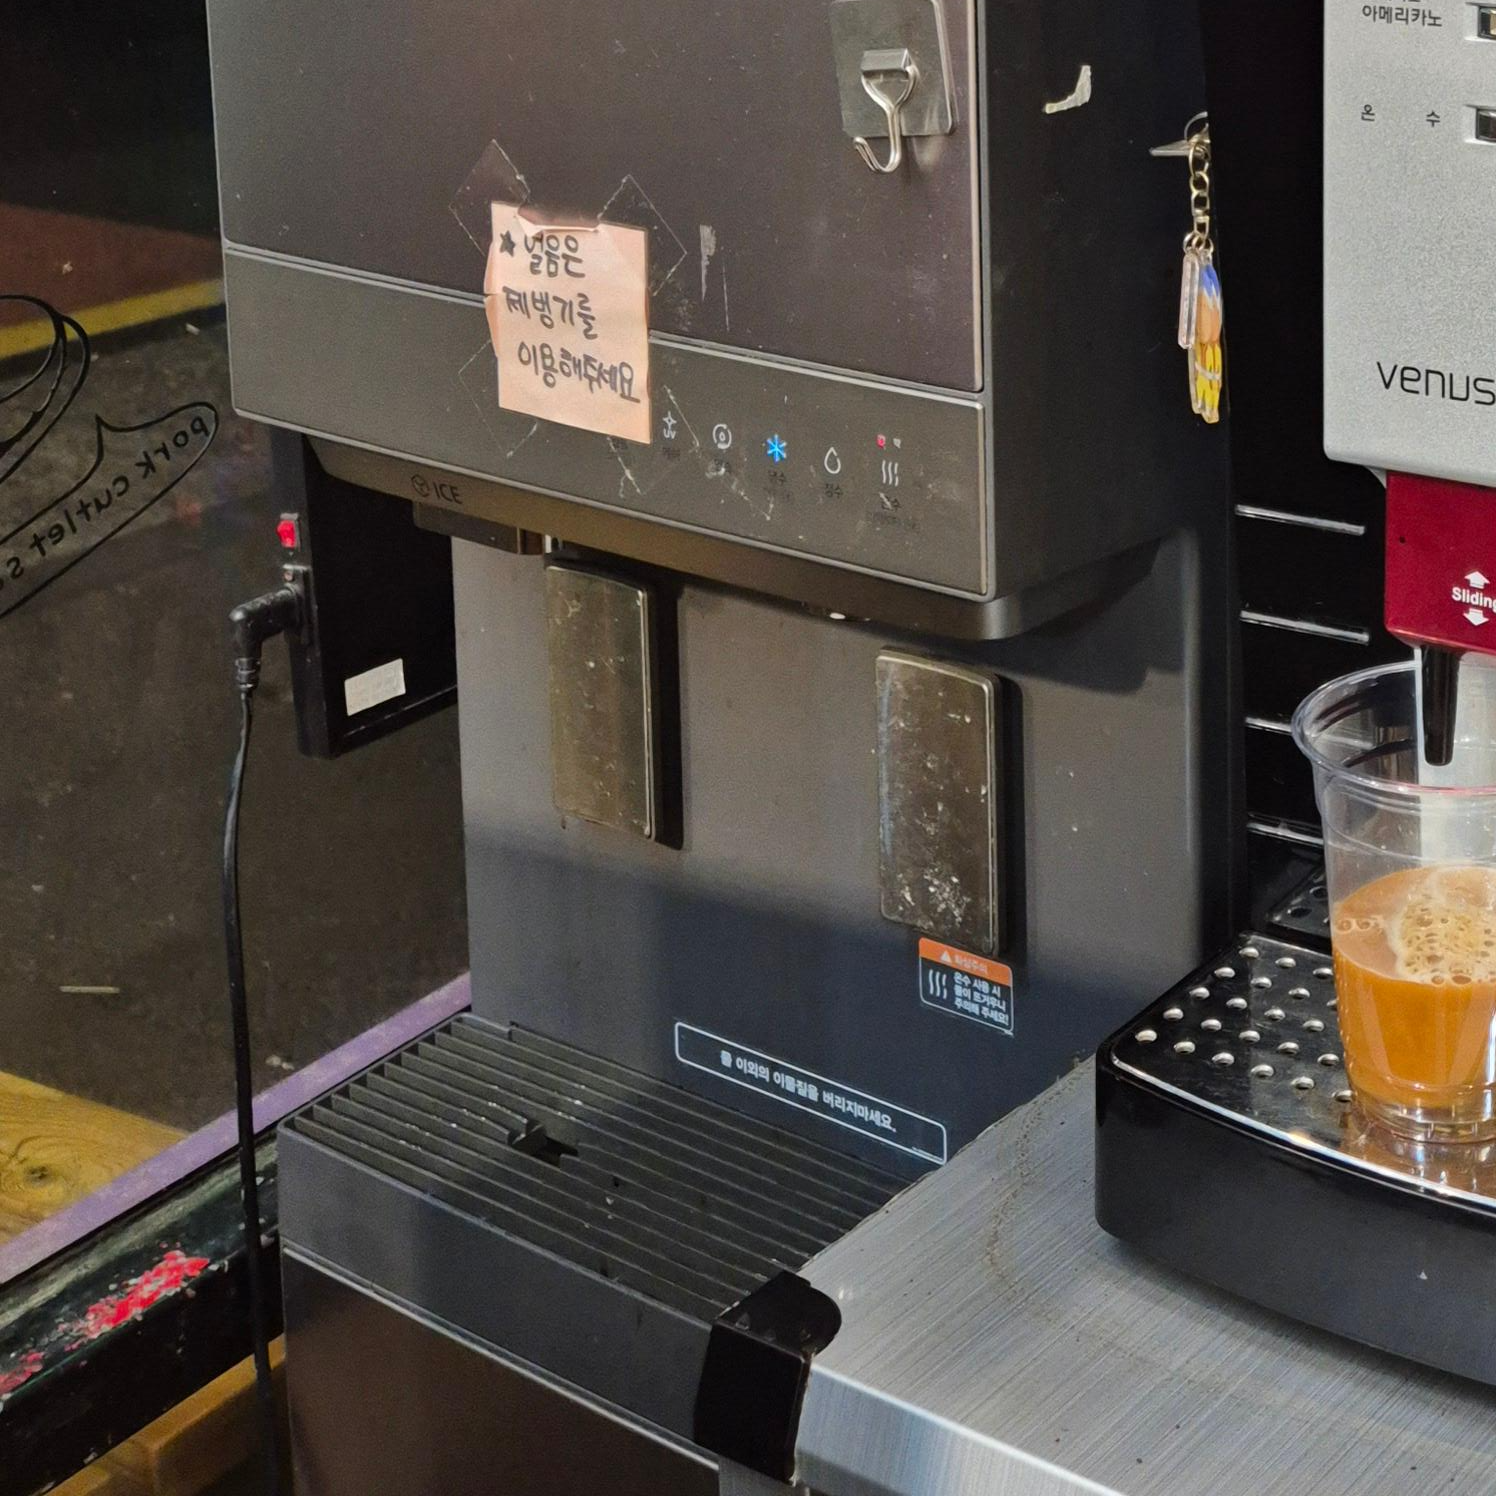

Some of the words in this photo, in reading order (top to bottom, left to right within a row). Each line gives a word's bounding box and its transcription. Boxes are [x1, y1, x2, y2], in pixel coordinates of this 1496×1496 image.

[1361, 5, 1443, 28] 아메리카노
[517, 340, 641, 404] 이용해주세요
[663, 429, 677, 440] UV
[432, 481, 463, 505] ICE
